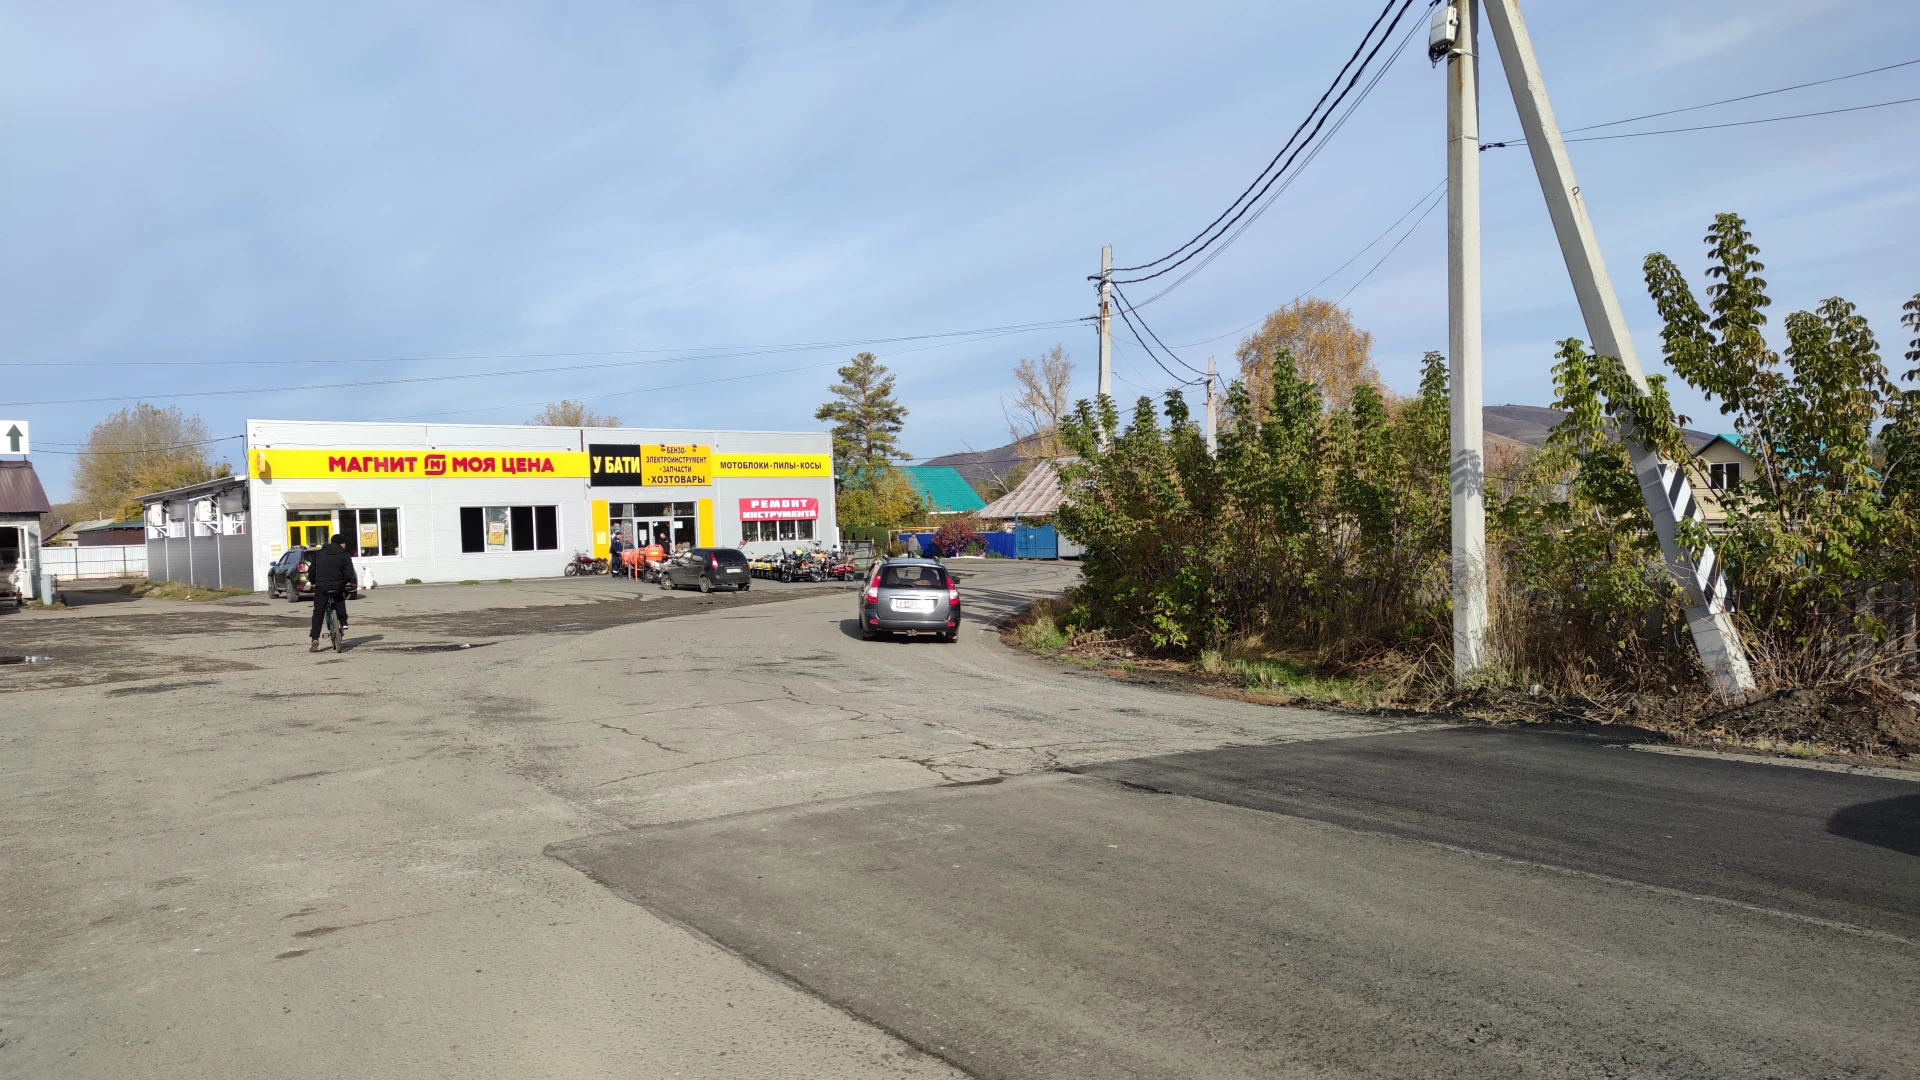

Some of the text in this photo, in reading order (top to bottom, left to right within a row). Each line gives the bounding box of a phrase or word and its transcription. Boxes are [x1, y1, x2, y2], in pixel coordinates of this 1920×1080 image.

[645, 456, 707, 464] ЭЛЕКТРОИНСТРУМЕНТ
[328, 456, 418, 472] МАГНИТ
[452, 456, 496, 473] МОЯ
[501, 457, 555, 475] ЦЕНА
[592, 456, 641, 474] У БАТИ
[651, 475, 706, 484] ХОЗТОВАРЫ
[750, 499, 808, 509] РЕМОНТ
[742, 510, 817, 519] ИНСТРУМЕНТА
